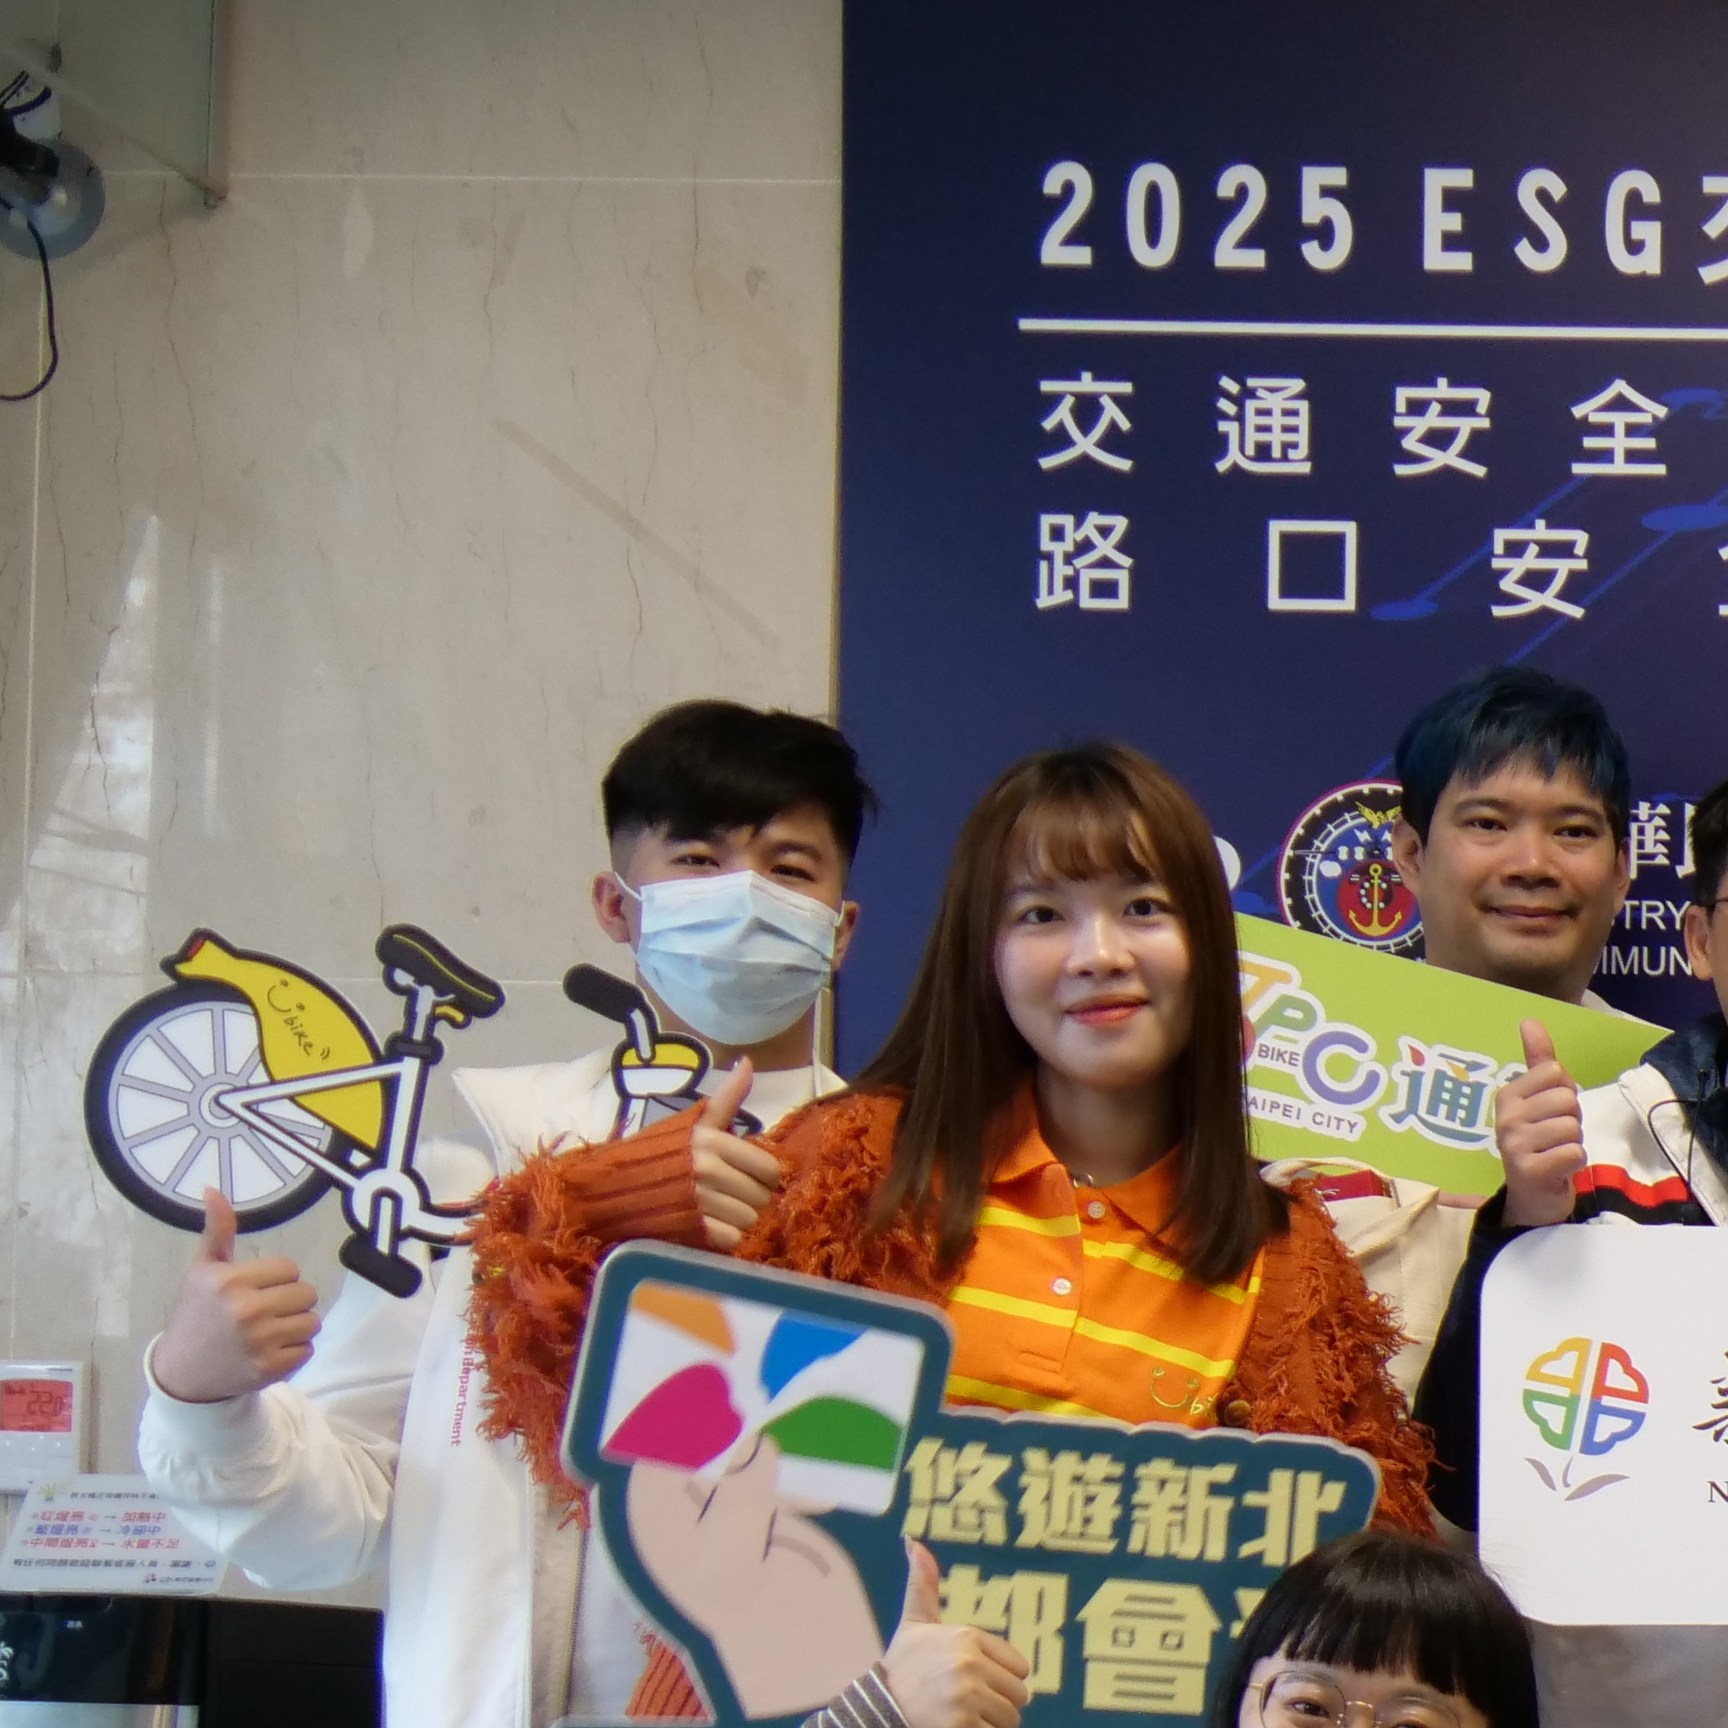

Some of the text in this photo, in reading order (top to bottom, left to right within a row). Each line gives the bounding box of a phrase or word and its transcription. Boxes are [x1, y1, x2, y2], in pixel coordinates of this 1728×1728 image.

[1039, 160, 1355, 272] 2025
[1611, 900, 1691, 930] TRY
[1312, 1111, 1359, 1134] CITY
[902, 1436, 1349, 1568] 悠遊新北
